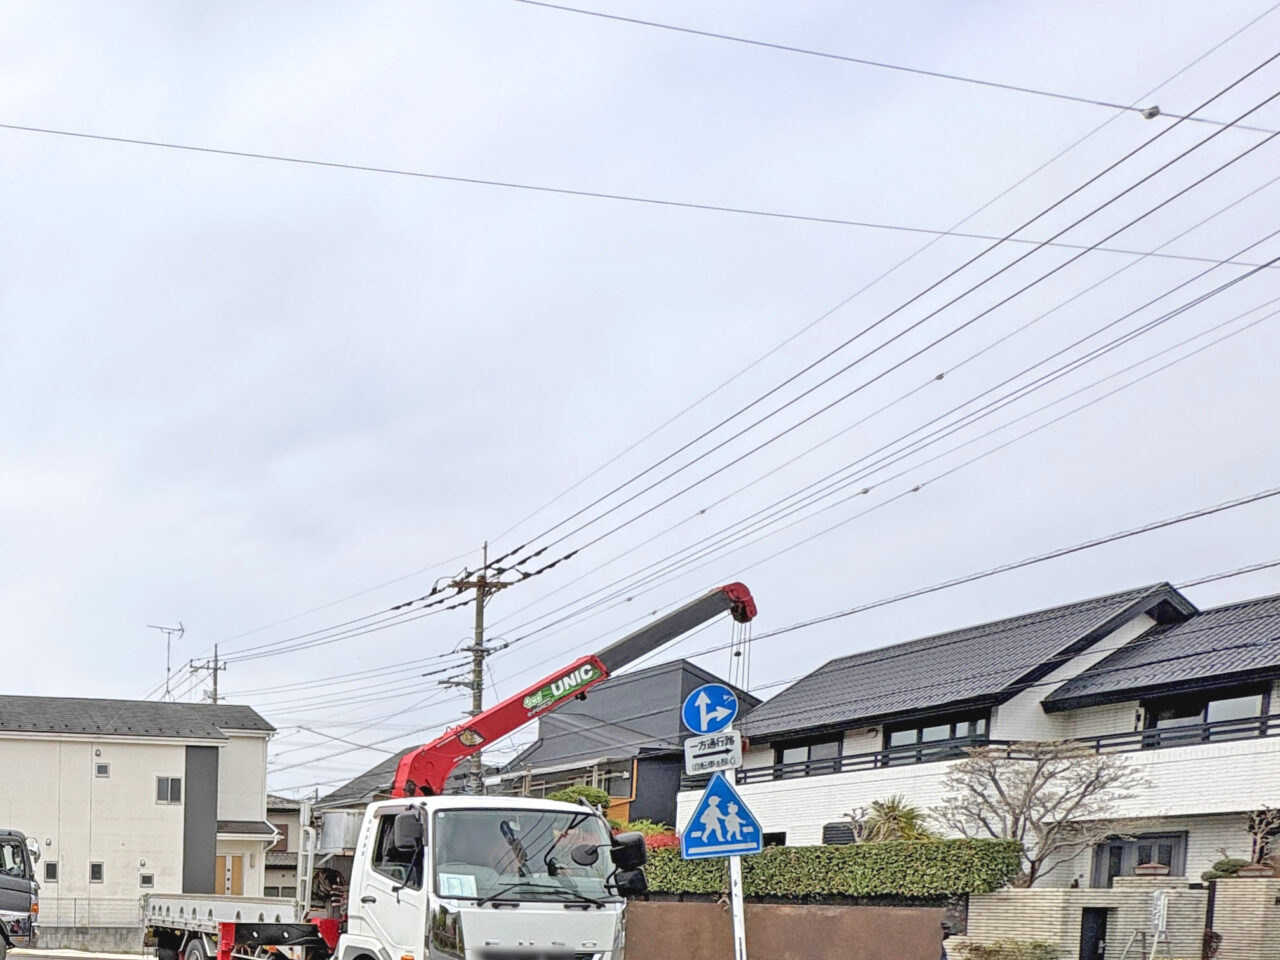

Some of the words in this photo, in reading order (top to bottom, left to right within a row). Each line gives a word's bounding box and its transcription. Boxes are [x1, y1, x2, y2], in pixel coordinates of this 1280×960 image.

[551, 664, 593, 696] UNIC
[689, 736, 735, 751] 一方通行路
